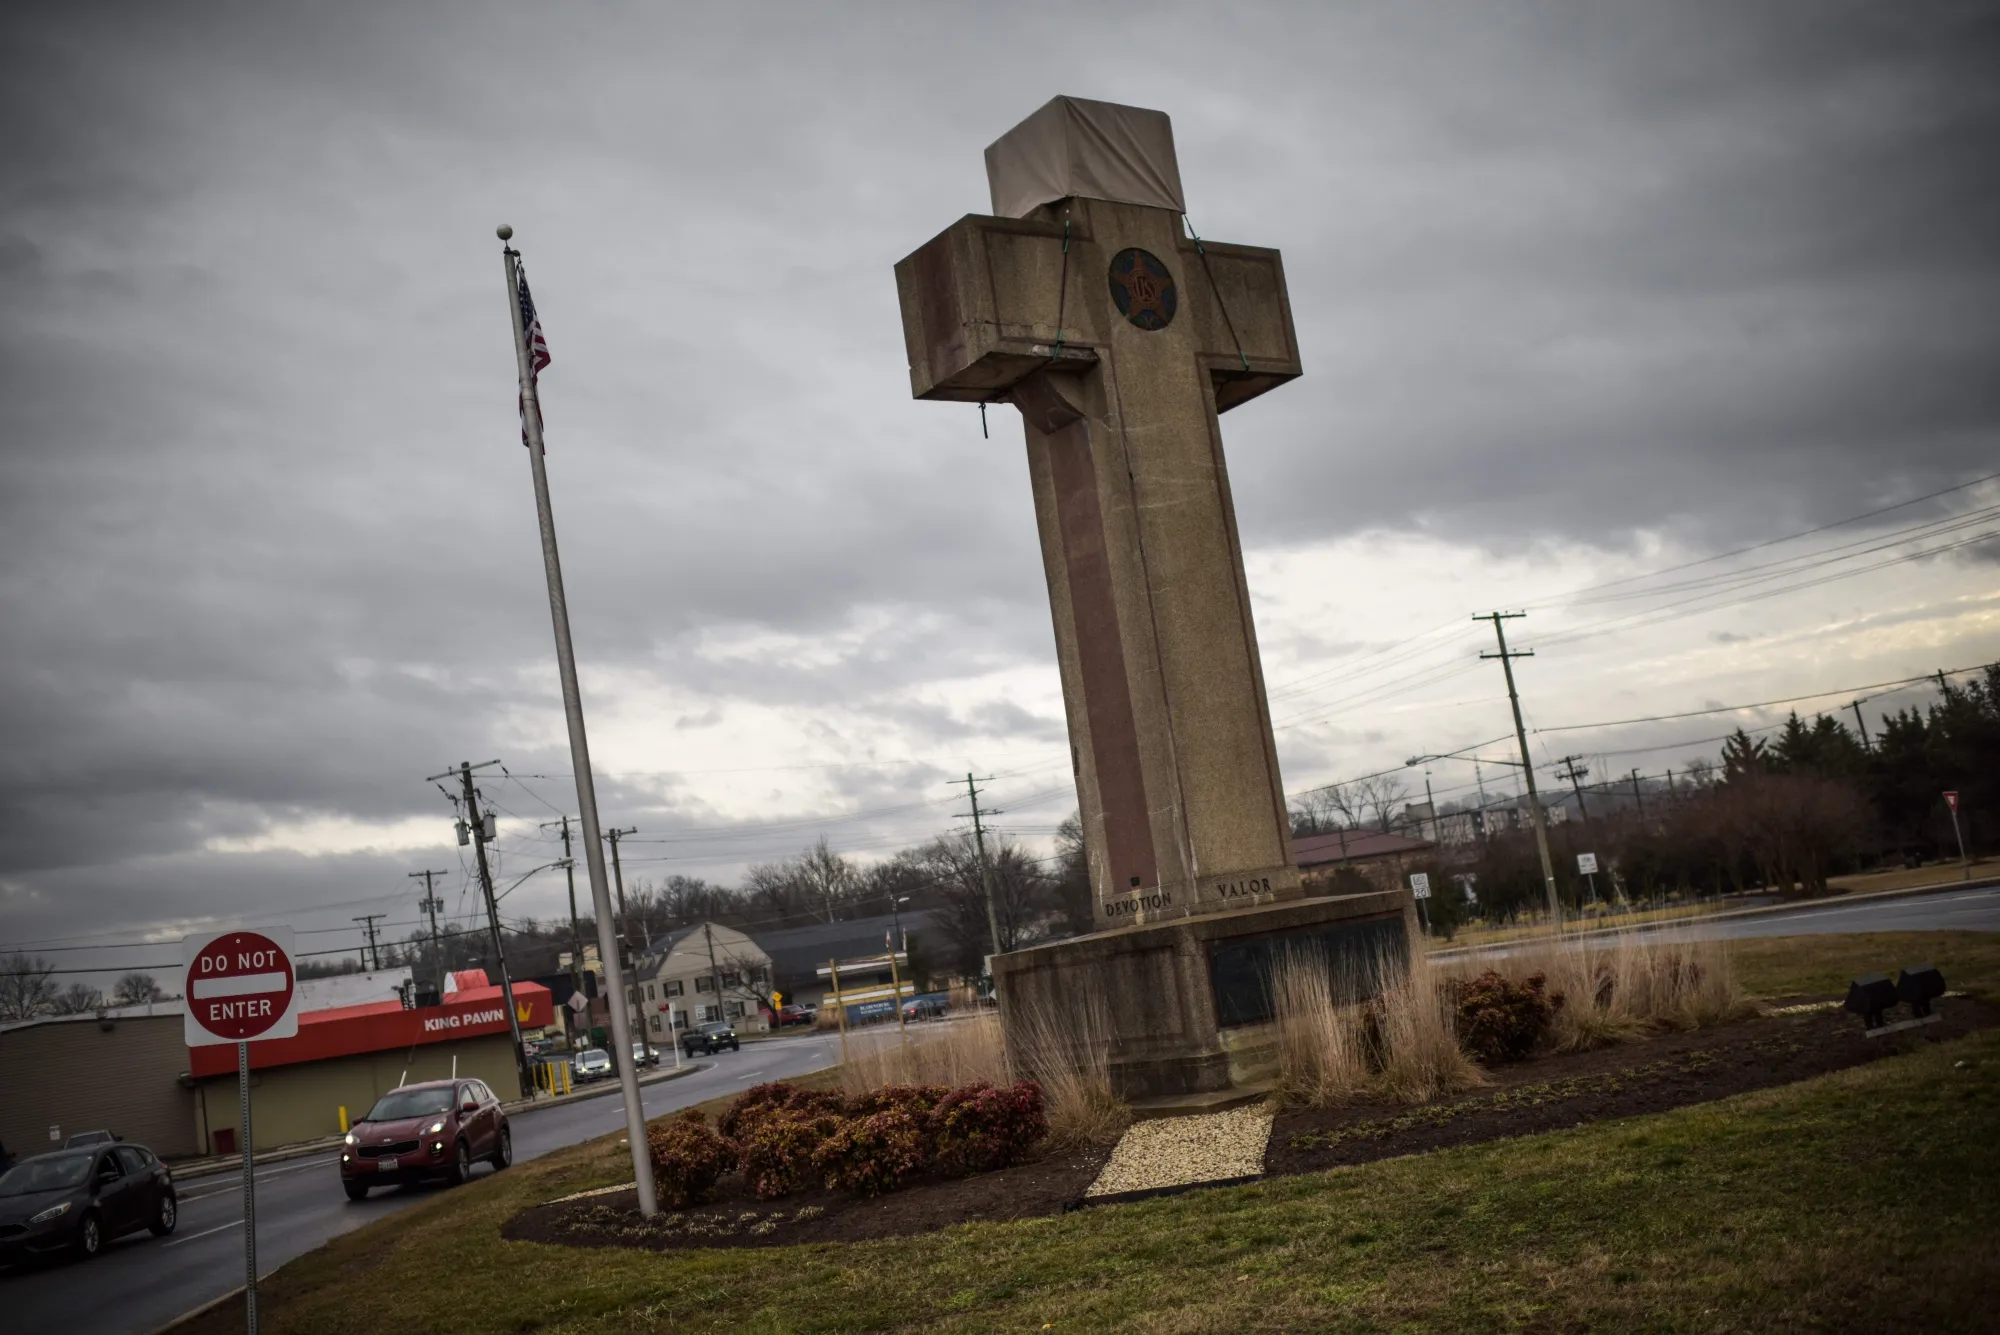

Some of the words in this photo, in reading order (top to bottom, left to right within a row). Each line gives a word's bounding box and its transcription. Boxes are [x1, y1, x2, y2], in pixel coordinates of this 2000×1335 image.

[1217, 878, 1272, 898] VALOR
[1105, 892, 1172, 917] DEVOTION
[201, 955, 228, 973] DO
[238, 950, 277, 970] NOT
[210, 1000, 271, 1021] ENTER
[424, 1015, 460, 1032] KING
[462, 1009, 505, 1026] PAWN
